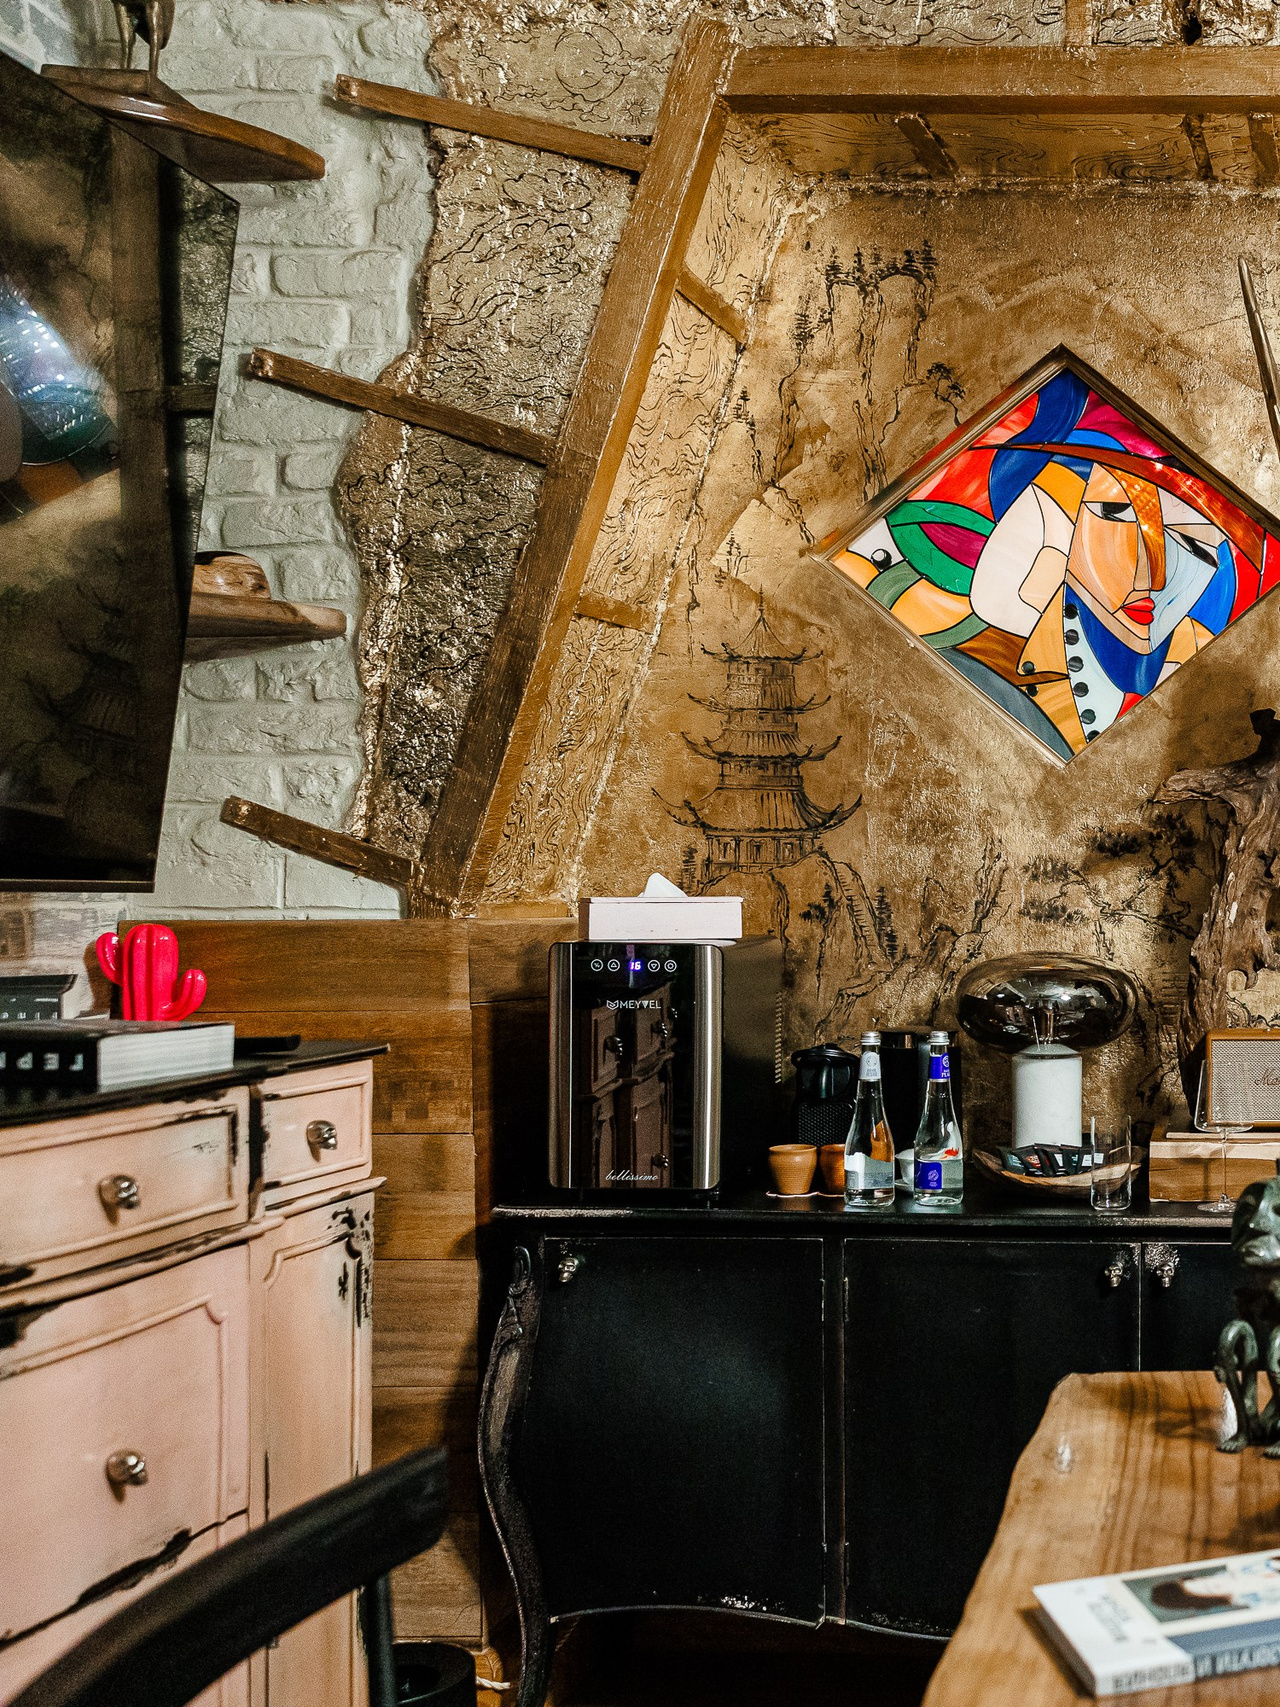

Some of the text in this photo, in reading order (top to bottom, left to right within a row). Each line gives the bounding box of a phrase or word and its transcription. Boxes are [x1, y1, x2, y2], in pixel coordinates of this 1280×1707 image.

[630, 961, 642, 971] 16
[619, 1000, 662, 1009] MEYVEL
[605, 1169, 659, 1181] bellissimo
